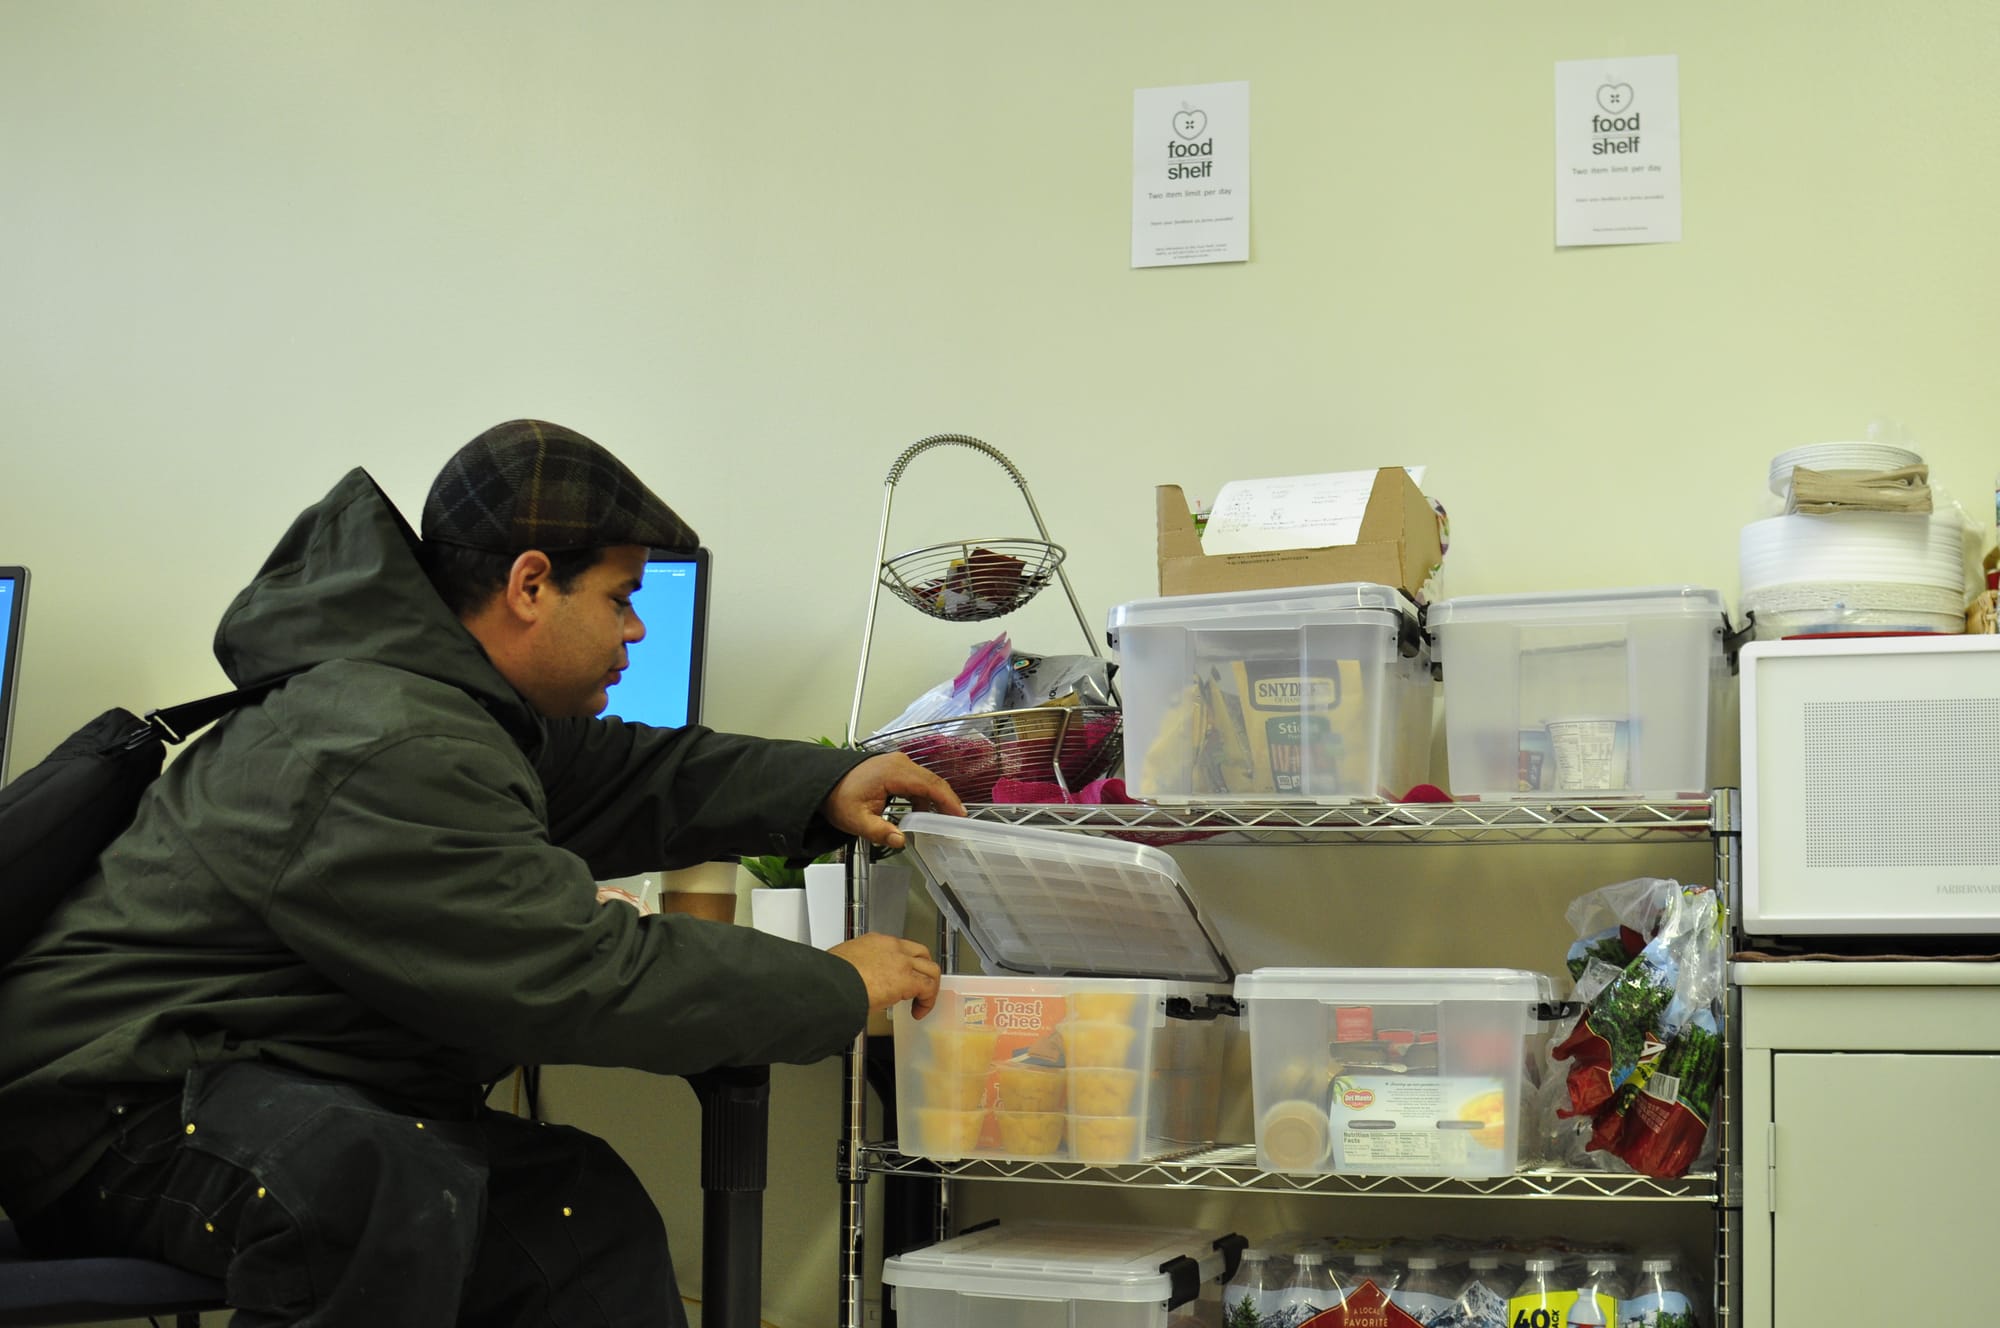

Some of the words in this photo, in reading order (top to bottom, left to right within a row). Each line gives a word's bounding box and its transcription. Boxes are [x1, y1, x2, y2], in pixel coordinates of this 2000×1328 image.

[1591, 112, 1640, 133] food
[1167, 137, 1213, 158] food
[1591, 136, 1640, 155] shelf
[1167, 160, 1213, 180] shelf
[1572, 167, 1588, 175] Two
[1647, 164, 1661, 172] day
[1185, 189, 1201, 197] limit
[1218, 188, 1232, 196] day
[995, 998, 1042, 1016] Toast
[995, 1013, 1041, 1030] Chee
[1360, 1307, 1380, 1315] LOCAL
[1513, 1308, 1550, 1328] 40
[1551, 1309, 1560, 1328] ACK
[1344, 1318, 1388, 1327] FAVORITE
